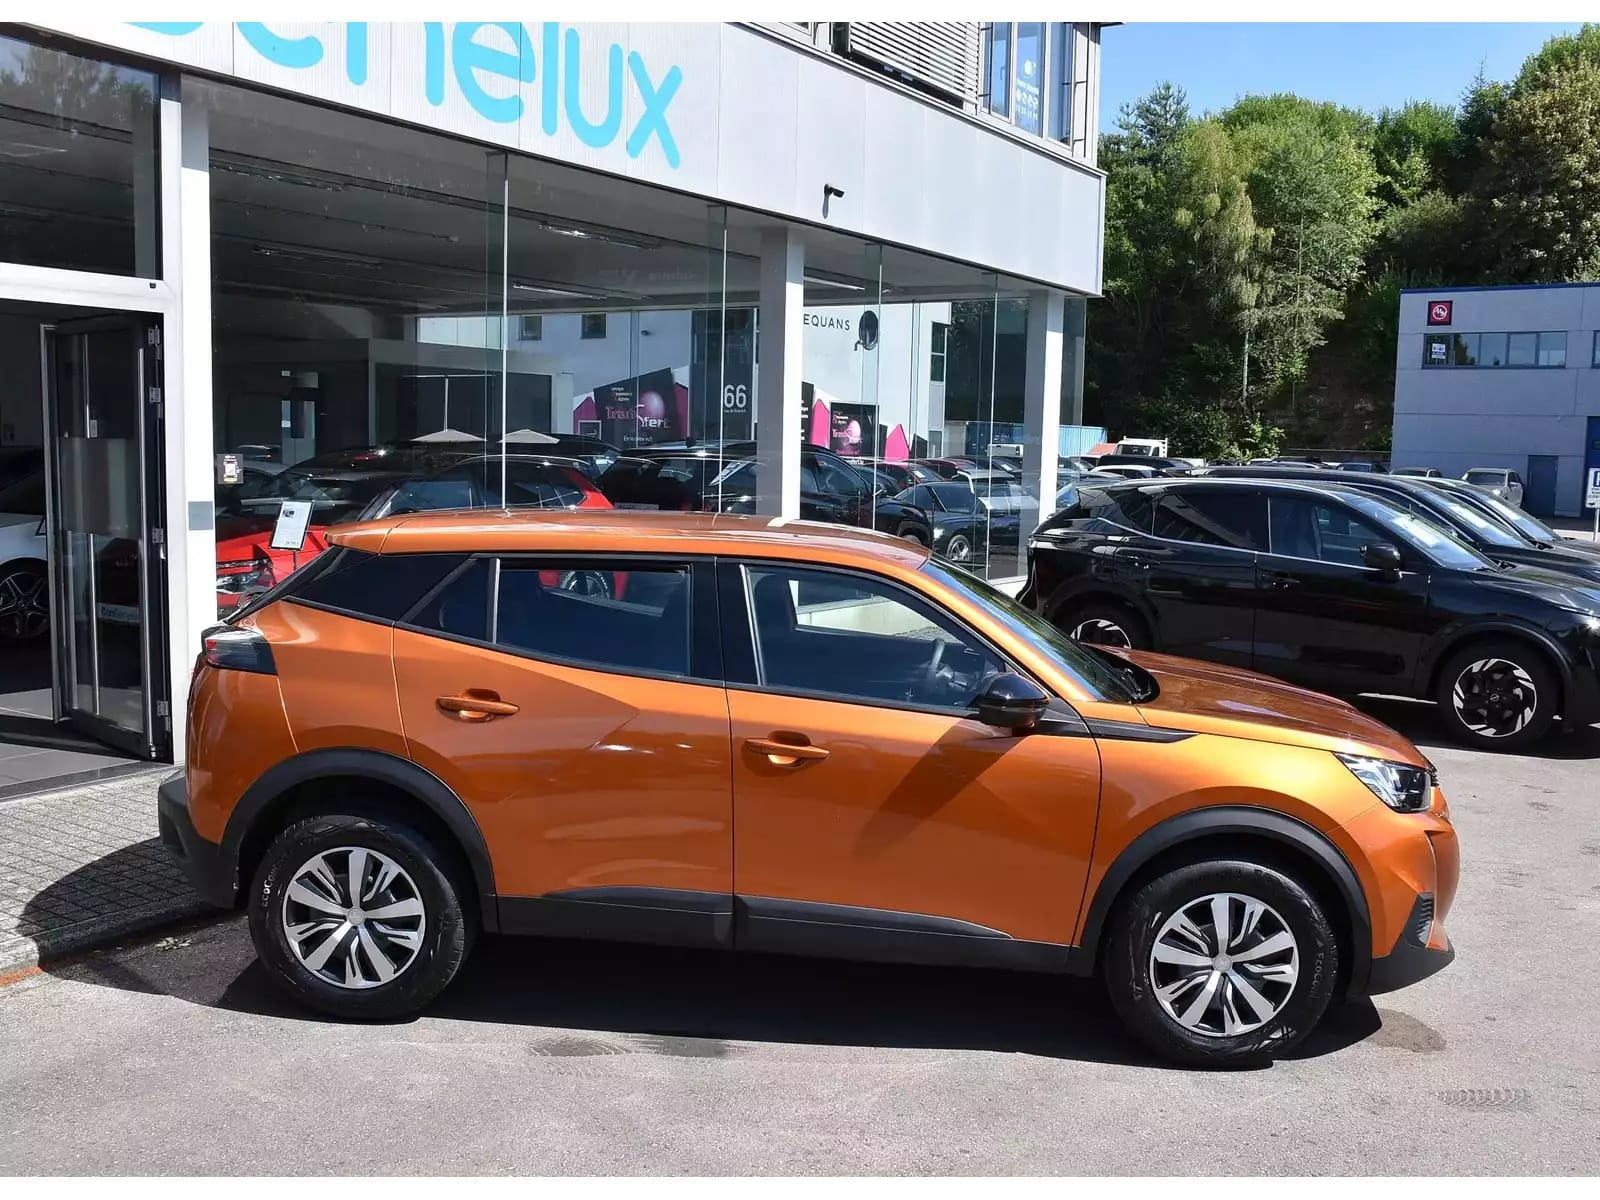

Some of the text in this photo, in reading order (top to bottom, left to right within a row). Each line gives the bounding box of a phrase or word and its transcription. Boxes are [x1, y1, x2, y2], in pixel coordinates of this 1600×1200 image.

[122, 22, 682, 170] nelux
[803, 313, 850, 331] EQUANS
[724, 384, 747, 408] 66
